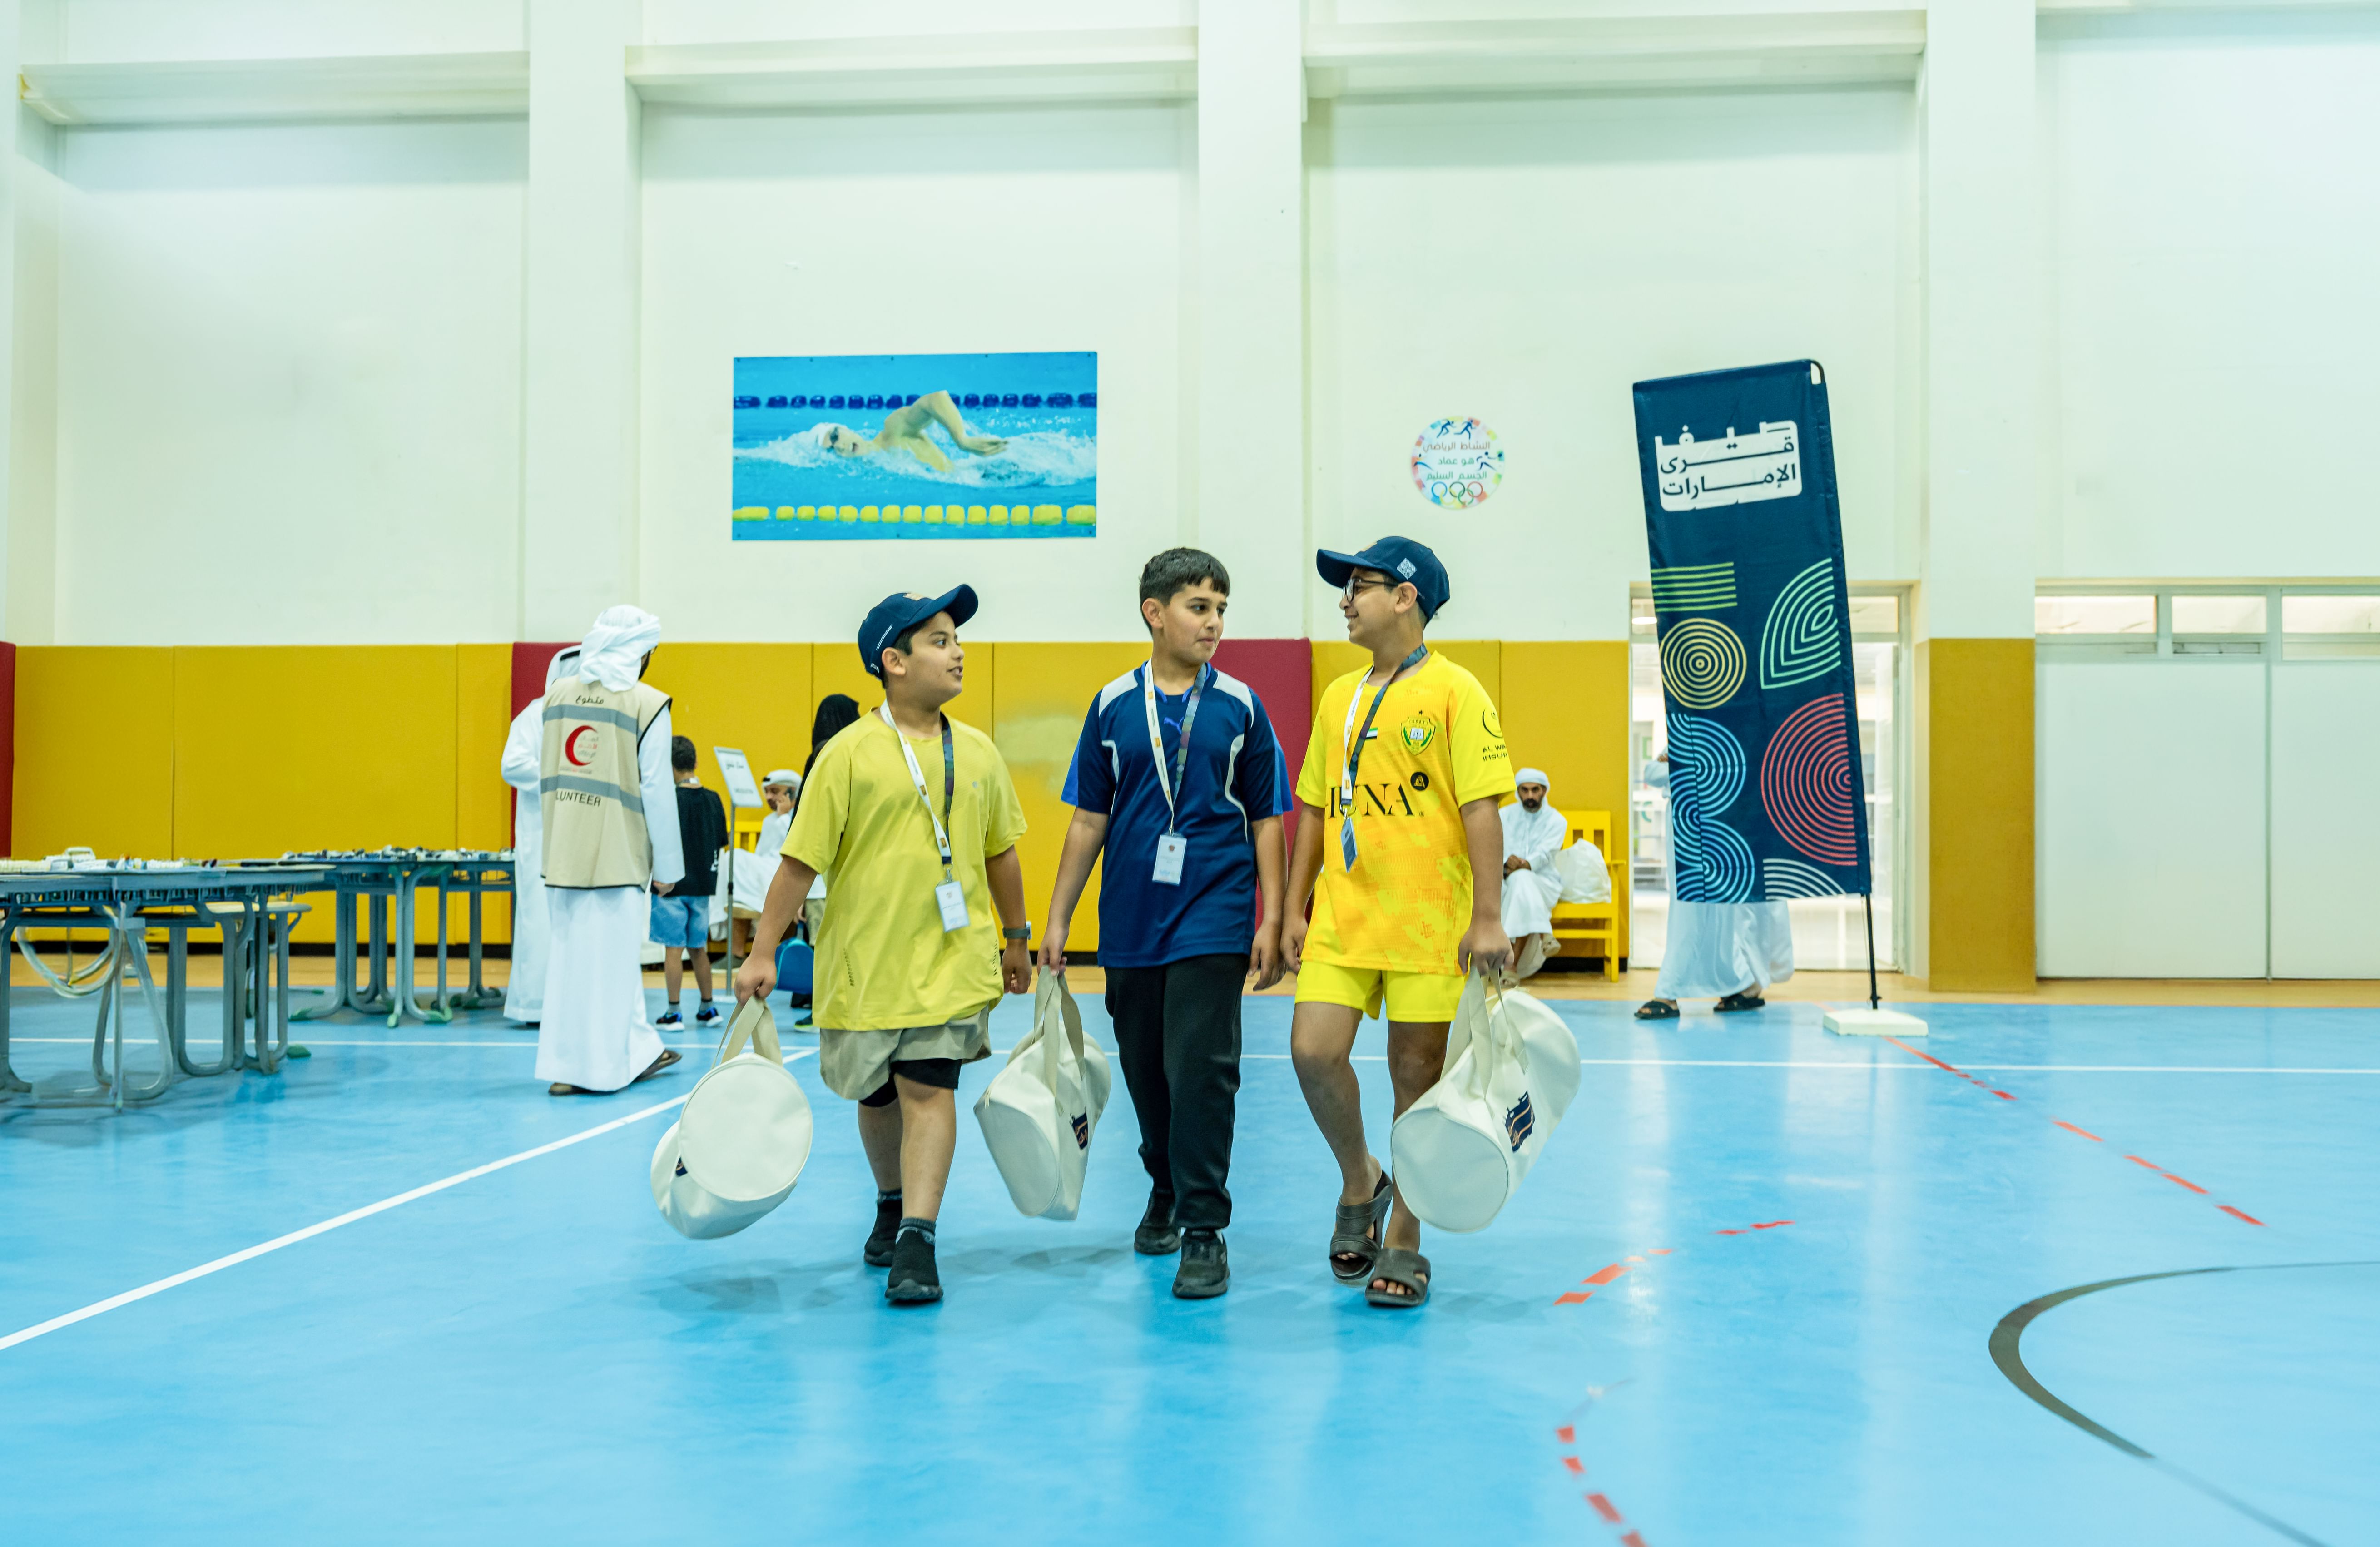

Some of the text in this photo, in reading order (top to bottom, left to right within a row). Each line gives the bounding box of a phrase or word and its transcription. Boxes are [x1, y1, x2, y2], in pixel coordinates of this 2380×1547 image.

[1423, 441, 1490, 452] النشاط الرياضي
[1661, 436, 1794, 474] قرى
[1438, 457, 1458, 465] عماد
[1427, 471, 1487, 481] الجسم السليم
[1662, 463, 1796, 499] الإمارات
[575, 695, 604, 705] متطوع
